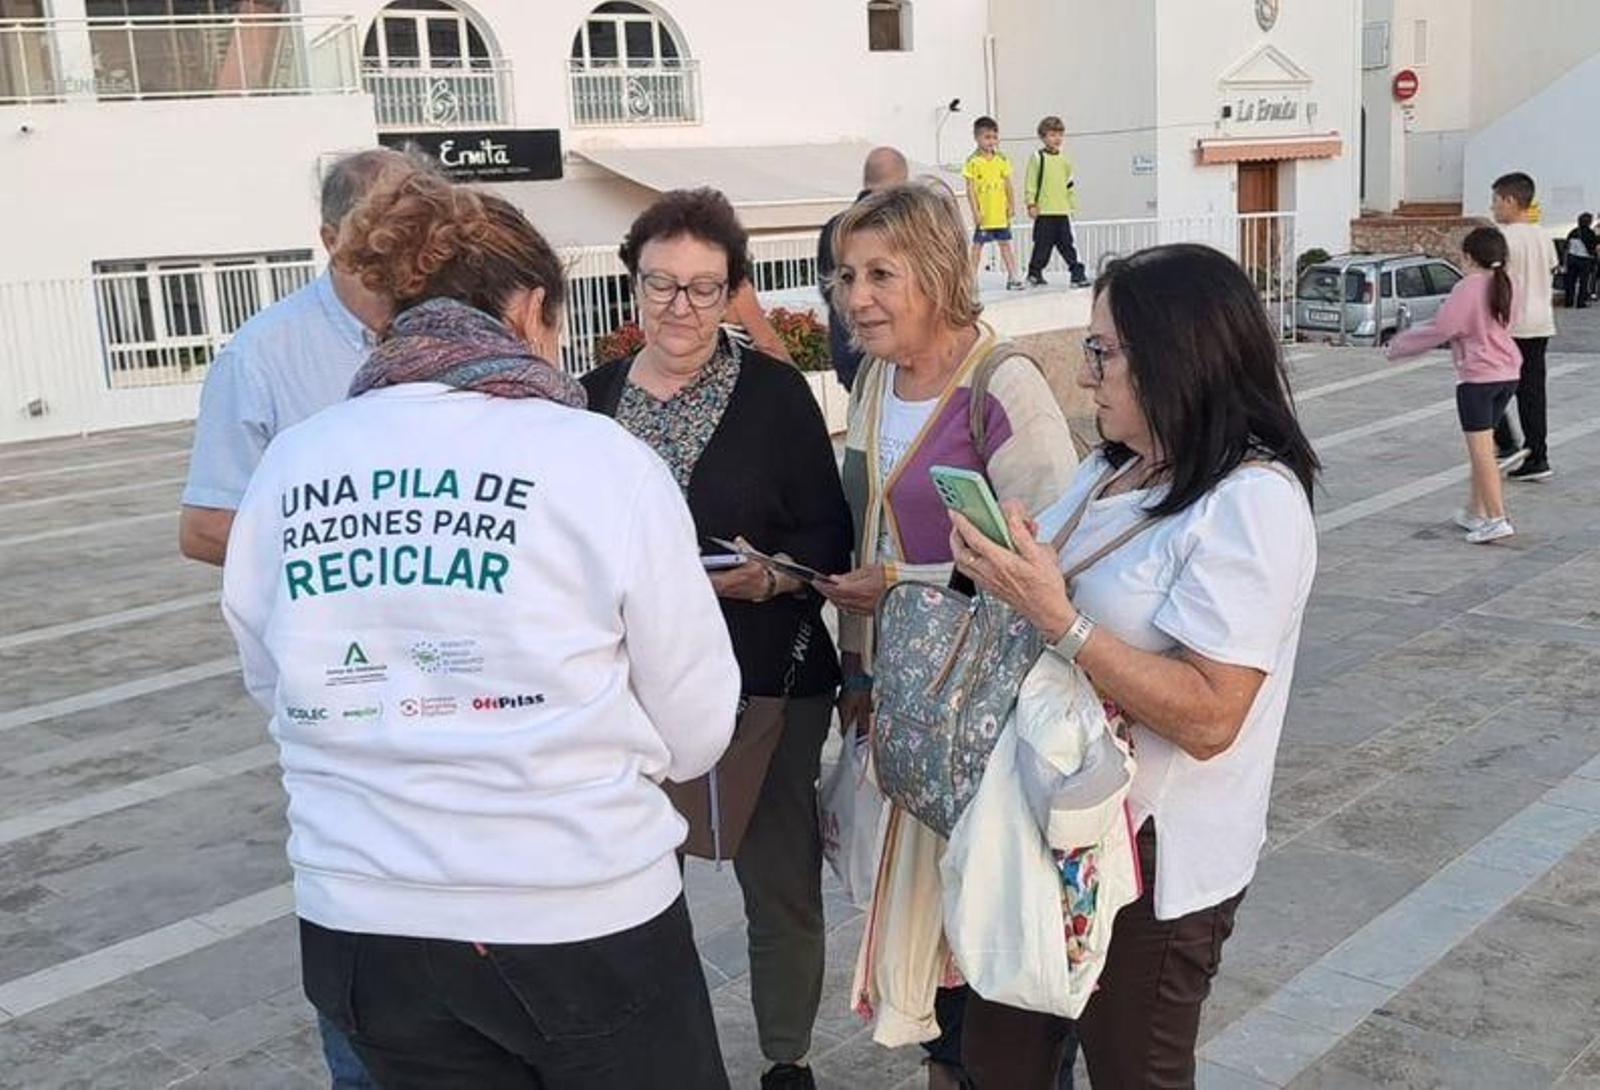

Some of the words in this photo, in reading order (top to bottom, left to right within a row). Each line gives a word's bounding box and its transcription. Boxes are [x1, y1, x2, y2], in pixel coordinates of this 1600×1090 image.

[439, 138, 511, 167] Ermita
[281, 474, 358, 519] UNA
[372, 468, 459, 501] PILA
[474, 472, 535, 511] DE
[283, 509, 423, 553] RAZONES
[432, 509, 516, 545] PARA
[285, 545, 510, 601] RECICLAR
